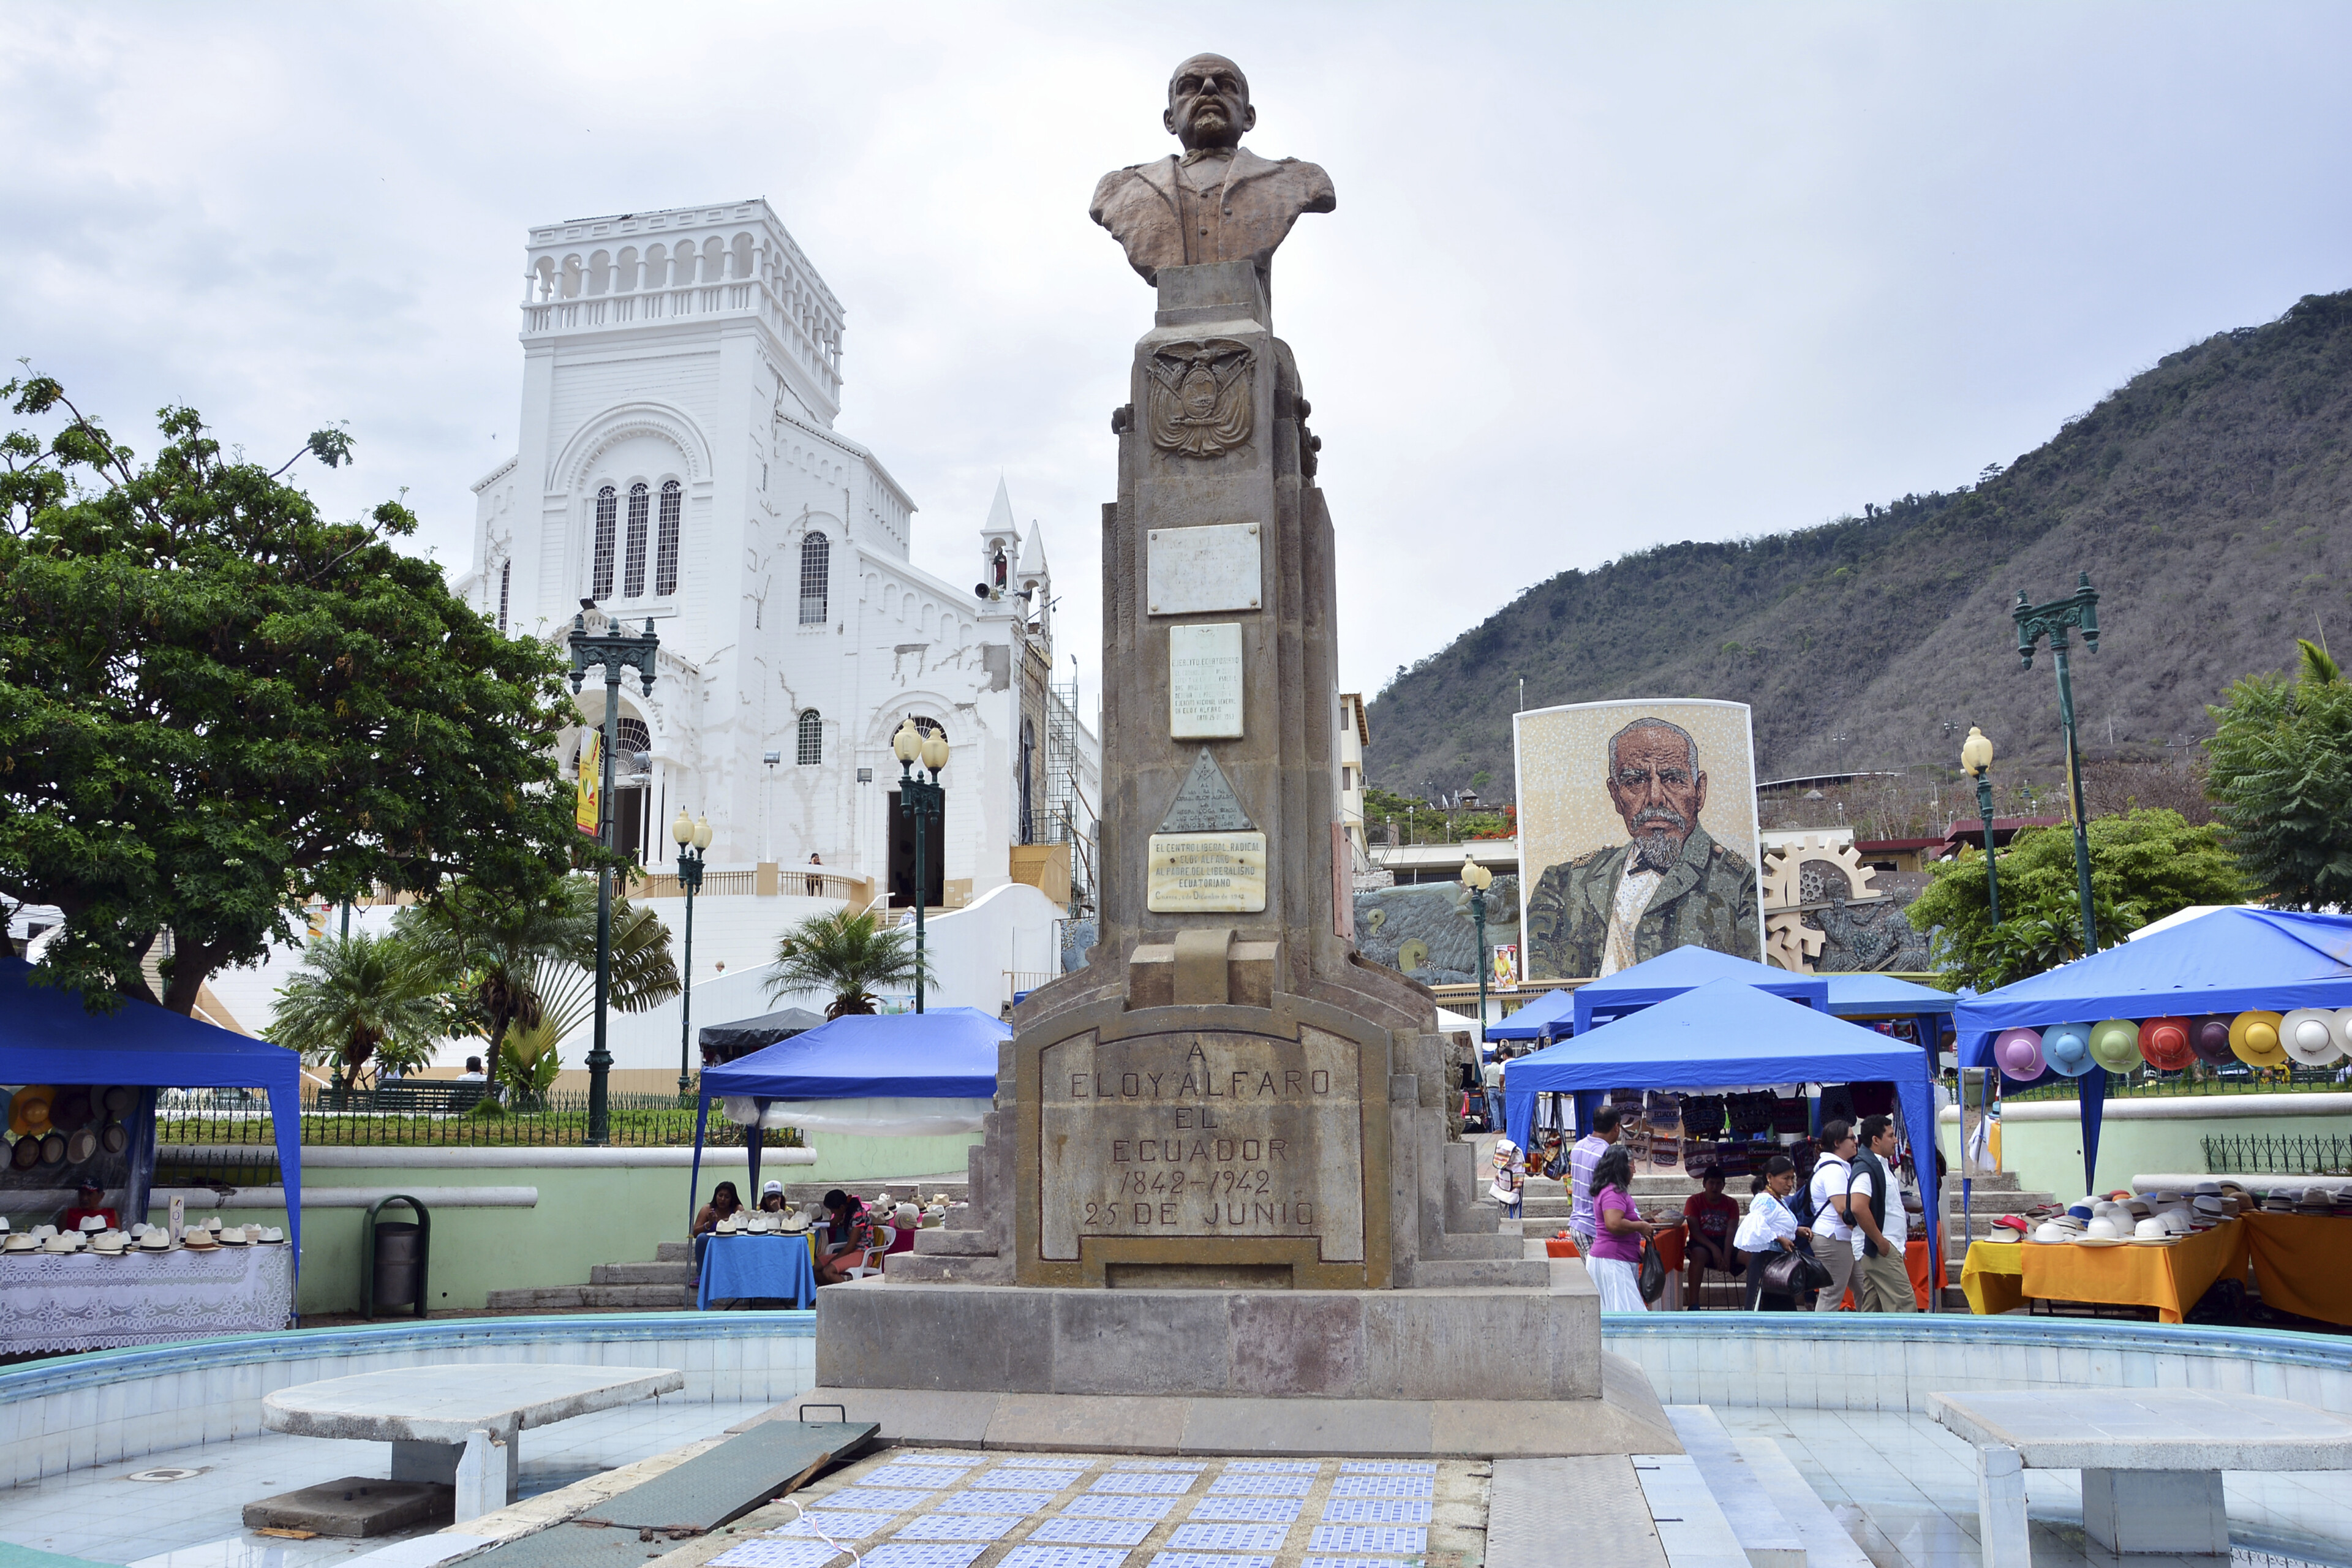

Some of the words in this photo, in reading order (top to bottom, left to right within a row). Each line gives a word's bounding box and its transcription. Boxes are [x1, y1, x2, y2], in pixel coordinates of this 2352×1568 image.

[1156, 843, 1164, 852] EL
[1166, 843, 1195, 852] CENTRO
[1230, 842, 1261, 852] RADICAL
[1156, 867, 1164, 876] AL
[1207, 866, 1256, 876] LIBERALISMO
[1178, 878, 1231, 888] ECUATORIANO
[1186, 1041, 1207, 1063] A
[1071, 1072, 1163, 1099] ELOY
[1179, 1069, 1330, 1098] ALFARO
[1175, 1108, 1218, 1129] EL
[1113, 1139, 1288, 1163] ECUADOR
[1120, 1170, 1270, 1195] 1842-1942
[1084, 1202, 1118, 1226] 25
[1134, 1202, 1178, 1226] DE
[1204, 1202, 1314, 1226] JUNIO
